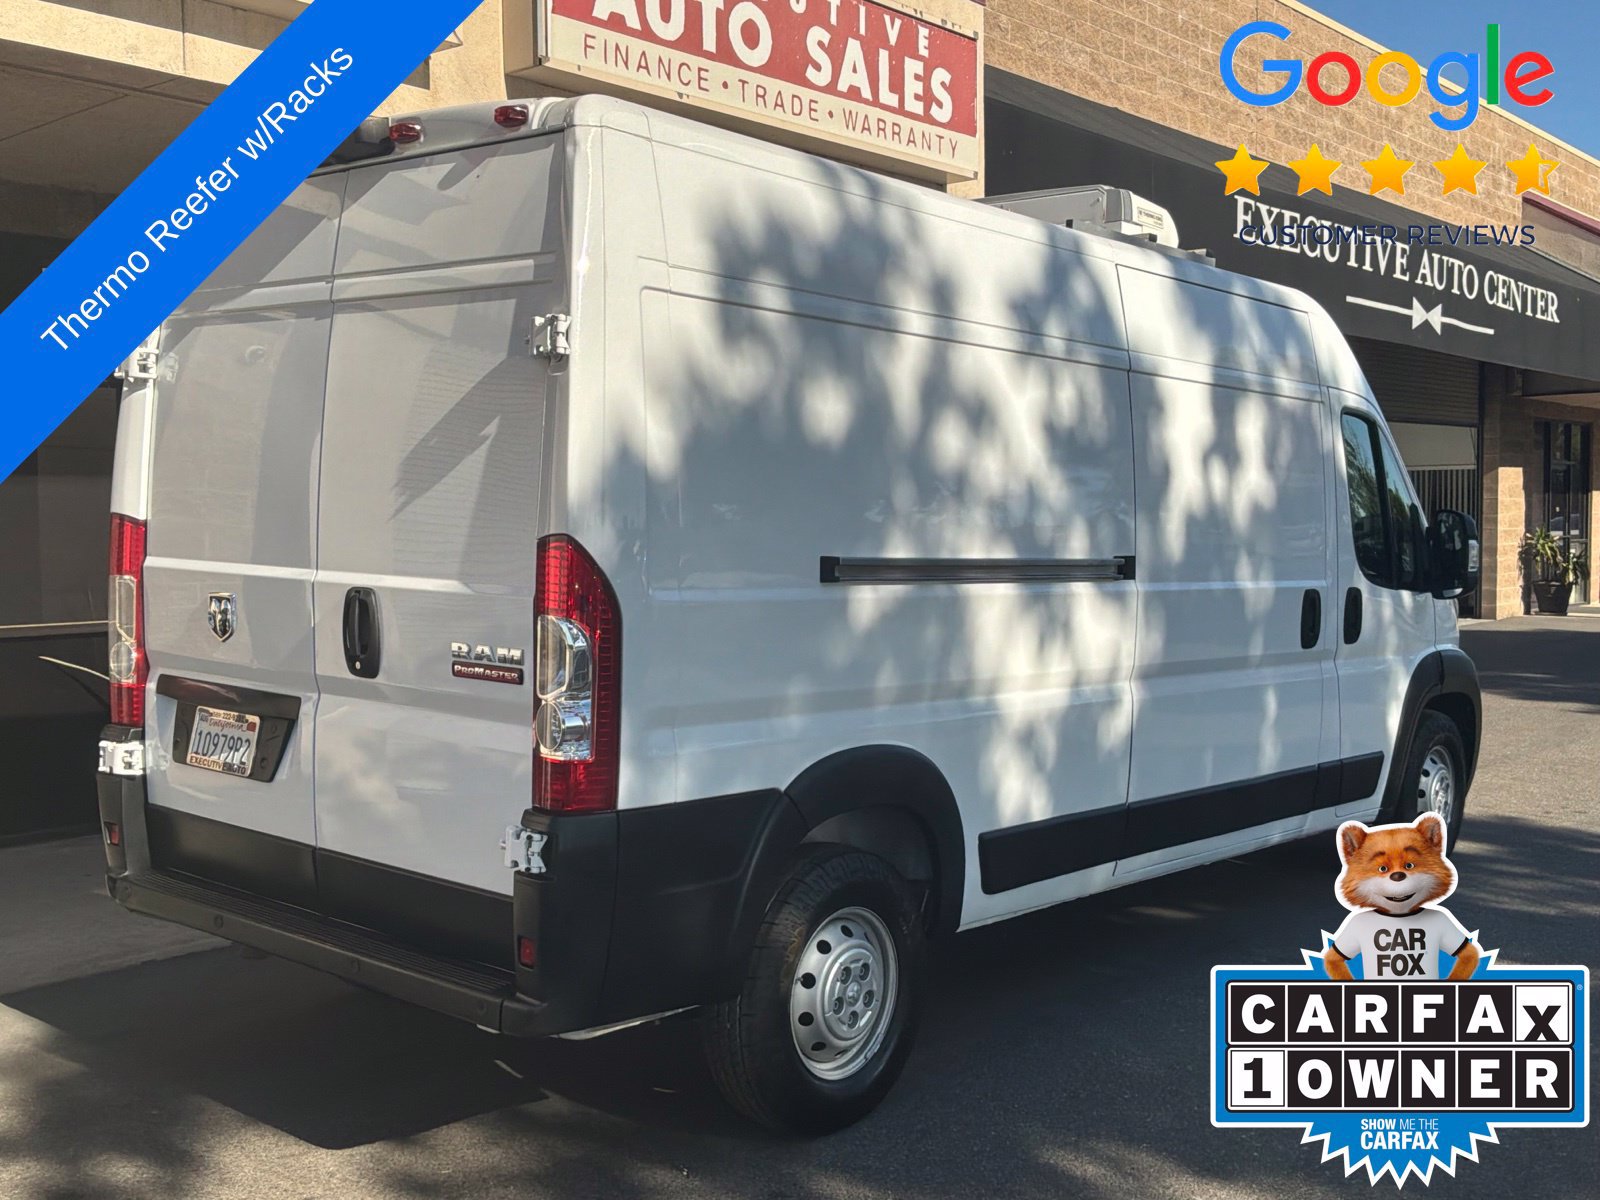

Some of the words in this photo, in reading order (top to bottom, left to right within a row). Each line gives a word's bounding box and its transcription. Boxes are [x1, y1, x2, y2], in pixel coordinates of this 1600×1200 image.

[583, 33, 711, 92] FINANCE
[738, 78, 819, 123] TRADE
[843, 108, 958, 159] WARRANTY
[805, 26, 952, 123] SALES
[1233, 195, 1410, 281] EXECUTIVE
[1415, 249, 1478, 299] AUTO
[1484, 270, 1560, 323] CENTER
[451, 642, 524, 666] RAM
